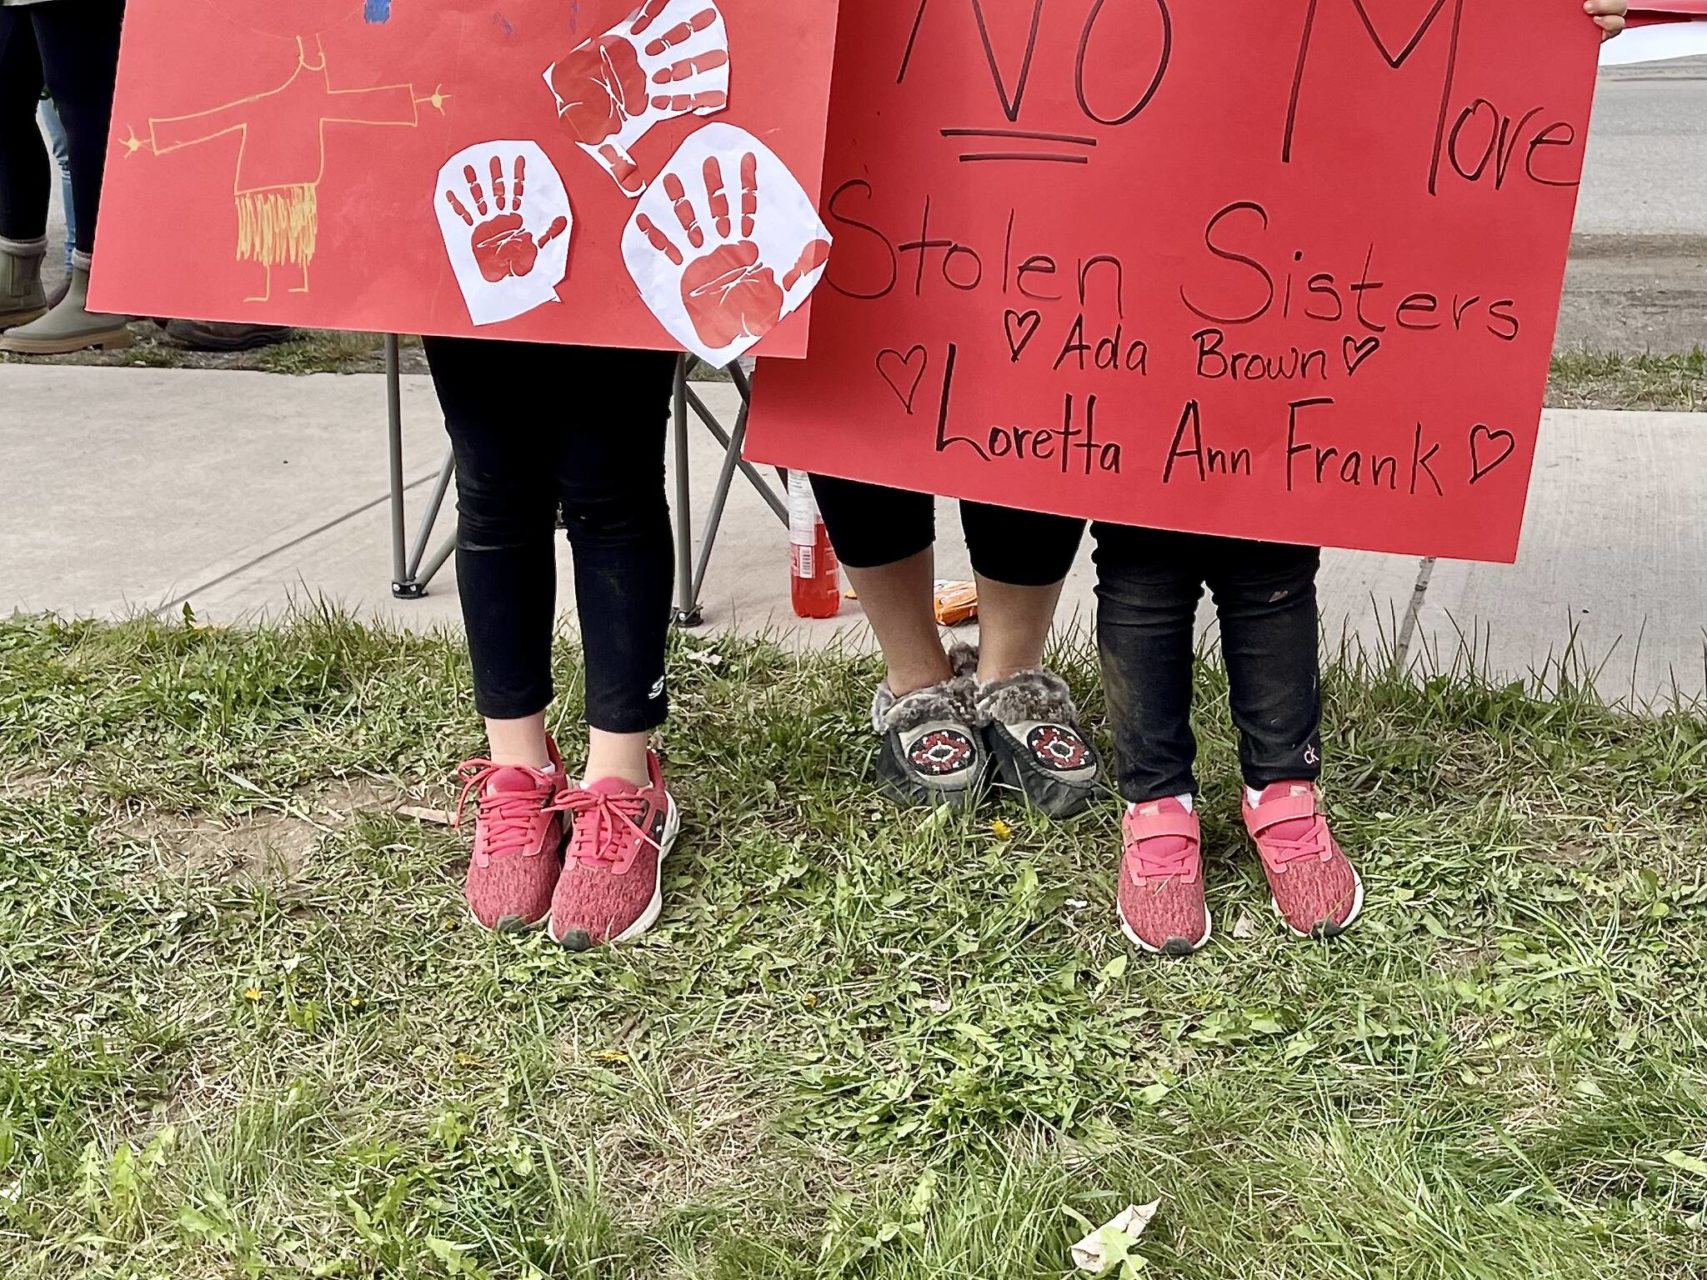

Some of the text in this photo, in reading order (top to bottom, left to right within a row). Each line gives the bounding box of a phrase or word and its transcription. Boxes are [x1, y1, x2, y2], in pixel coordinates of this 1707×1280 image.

[825, 178, 1520, 342] Stolen Sisters
[935, 342, 1444, 497] Loretta Ann Frank
[1052, 312, 1329, 381] Ada Brown
